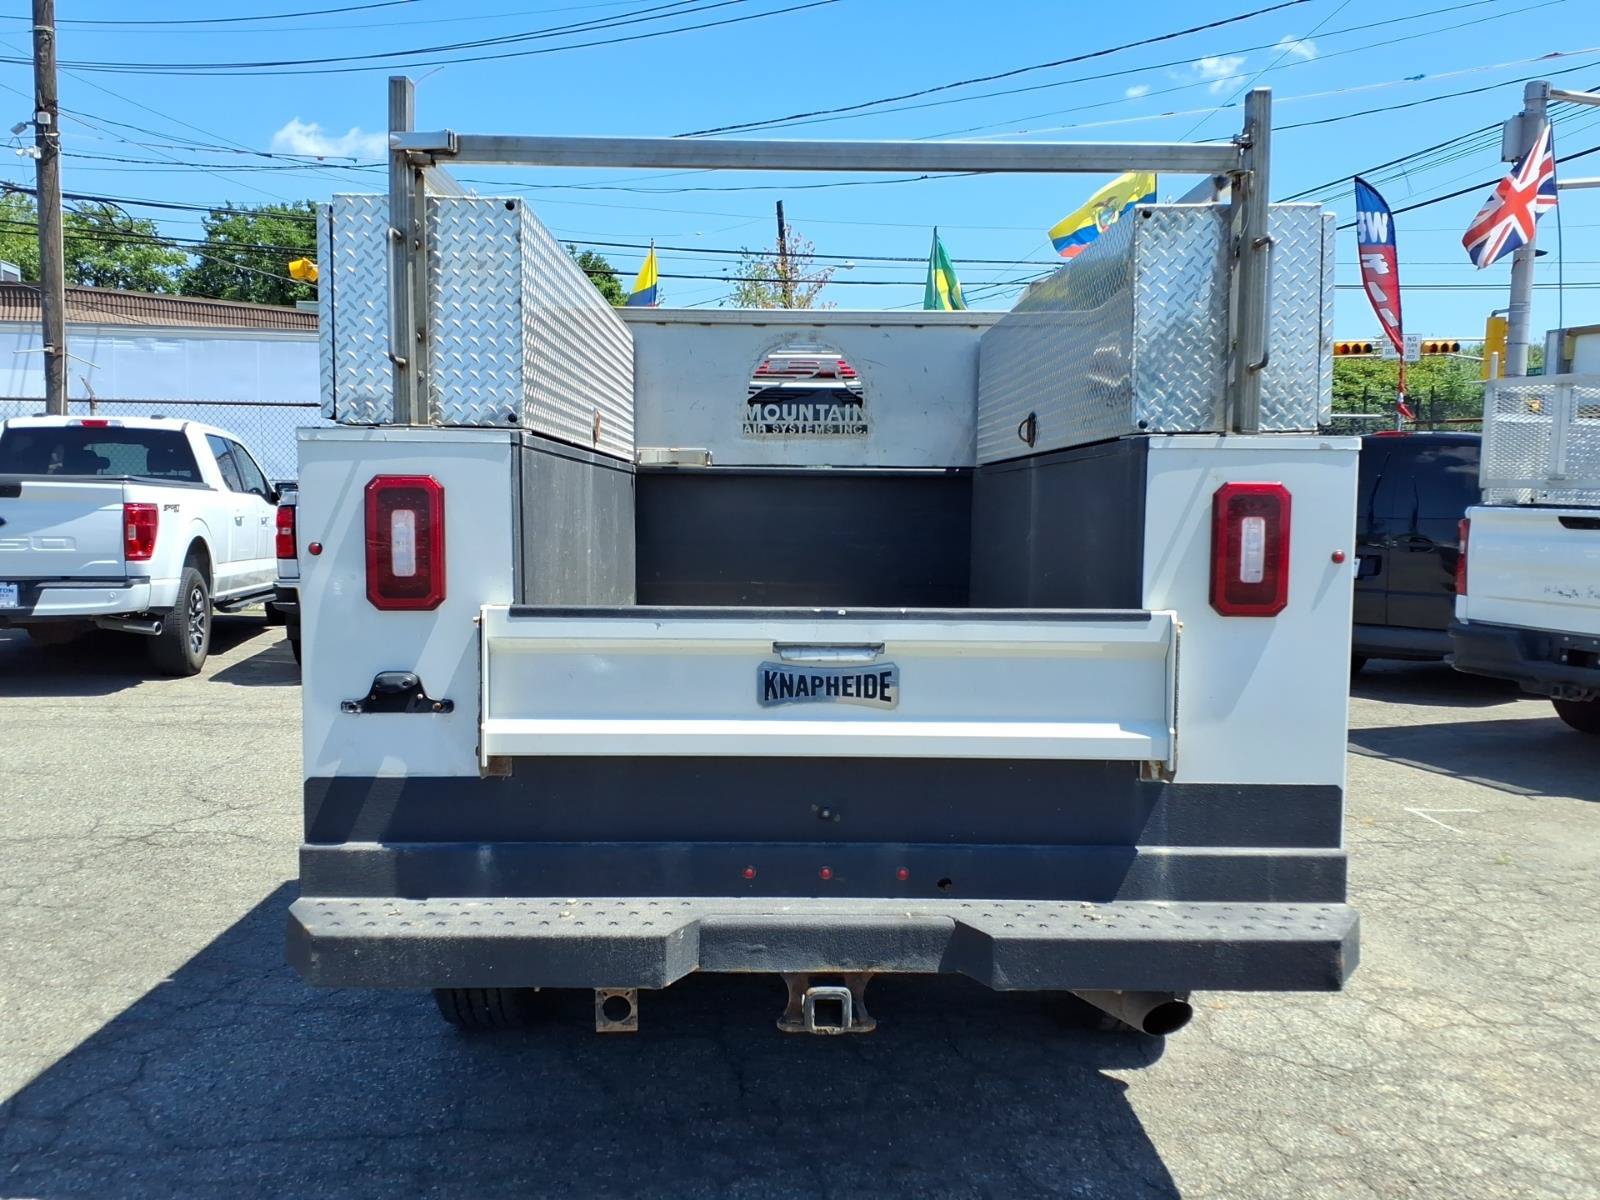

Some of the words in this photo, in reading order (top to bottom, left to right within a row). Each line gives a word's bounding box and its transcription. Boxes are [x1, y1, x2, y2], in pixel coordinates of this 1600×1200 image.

[744, 404, 866, 422] MOUNTAIN
[743, 424, 766, 434] AIR
[772, 424, 837, 434] SYSTEMS
[840, 424, 868, 434] INC.
[764, 670, 892, 702] KNAPHEIDE
